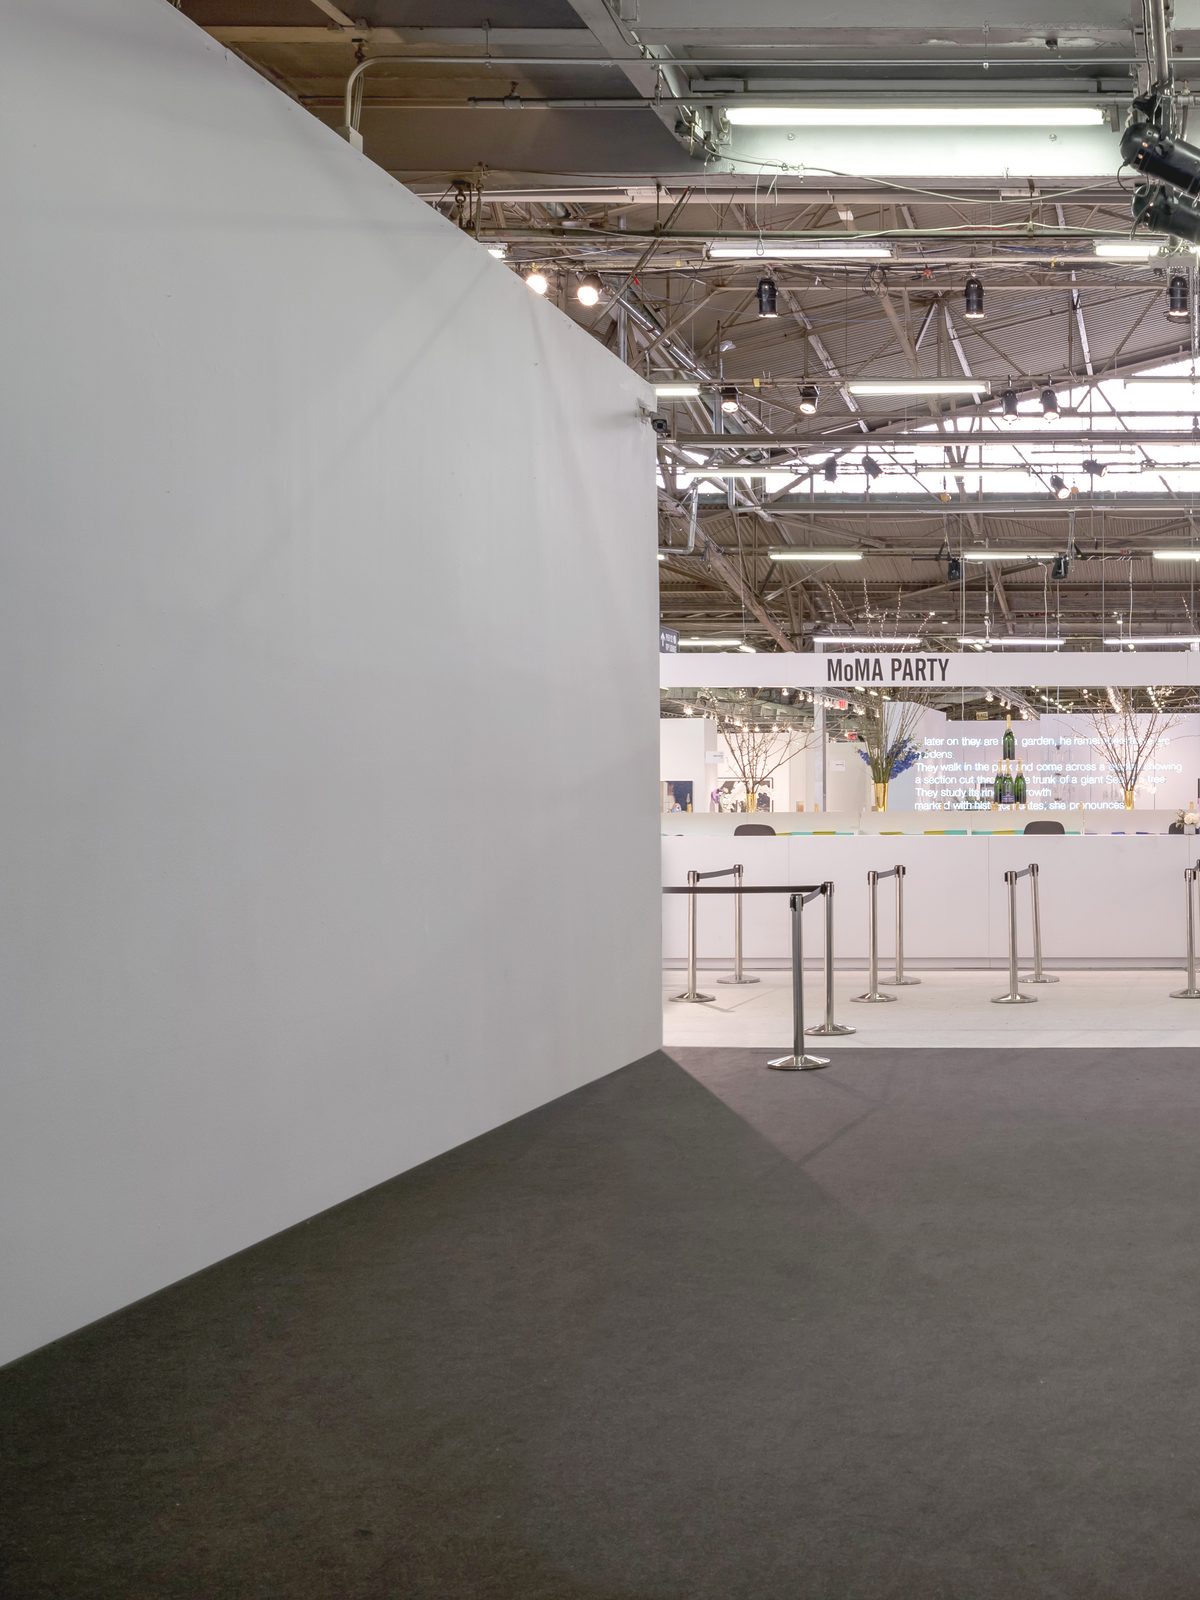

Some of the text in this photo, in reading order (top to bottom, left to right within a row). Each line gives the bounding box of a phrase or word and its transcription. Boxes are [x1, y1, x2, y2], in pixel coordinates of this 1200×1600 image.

[827, 658, 950, 682] MoMA PARTY
[924, 737, 945, 746] later
[946, 738, 959, 746] on
[961, 737, 981, 748] they
[984, 738, 999, 746] are
[1021, 736, 1056, 748] garden,
[1060, 736, 1072, 746] he
[915, 762, 938, 774] They
[940, 762, 962, 771] walk
[964, 762, 972, 771] in
[974, 762, 989, 771] the
[1036, 763, 1063, 772] come
[1065, 763, 1097, 772] across
[914, 776, 922, 785] a
[923, 775, 957, 785] section
[959, 775, 974, 784] cut
[1032, 775, 1056, 784] trunk
[1059, 775, 1070, 784] of
[1071, 776, 1078, 784] a
[1080, 775, 1104, 786] giant
[915, 787, 938, 799] They
[940, 787, 966, 799] study
[968, 787, 980, 797] its
[953, 801, 972, 810] with
[1049, 801, 1066, 810] she
[1069, 801, 1125, 812] prnounces
